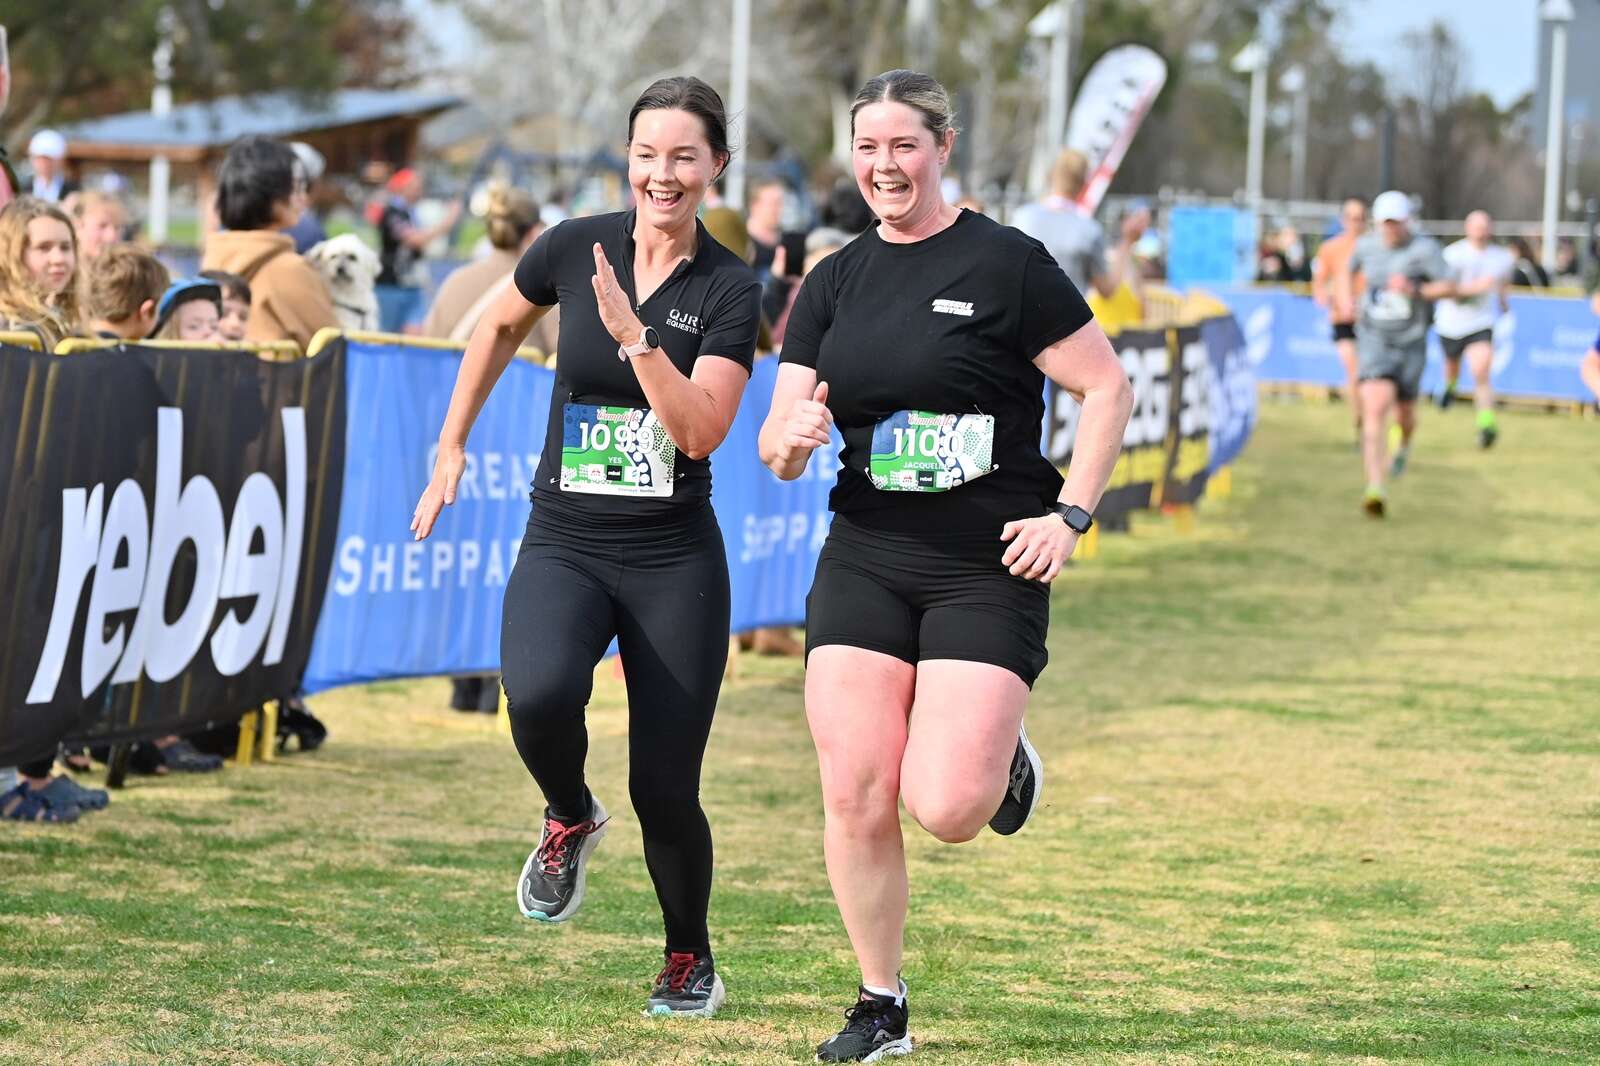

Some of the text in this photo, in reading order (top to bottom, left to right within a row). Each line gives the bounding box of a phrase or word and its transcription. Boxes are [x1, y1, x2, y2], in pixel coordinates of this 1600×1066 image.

[669, 308, 698, 327] QJR
[580, 422, 655, 454] 1099
[893, 427, 963, 457] 1100
[608, 456, 623, 464] YES
[25, 406, 307, 704] rebel
